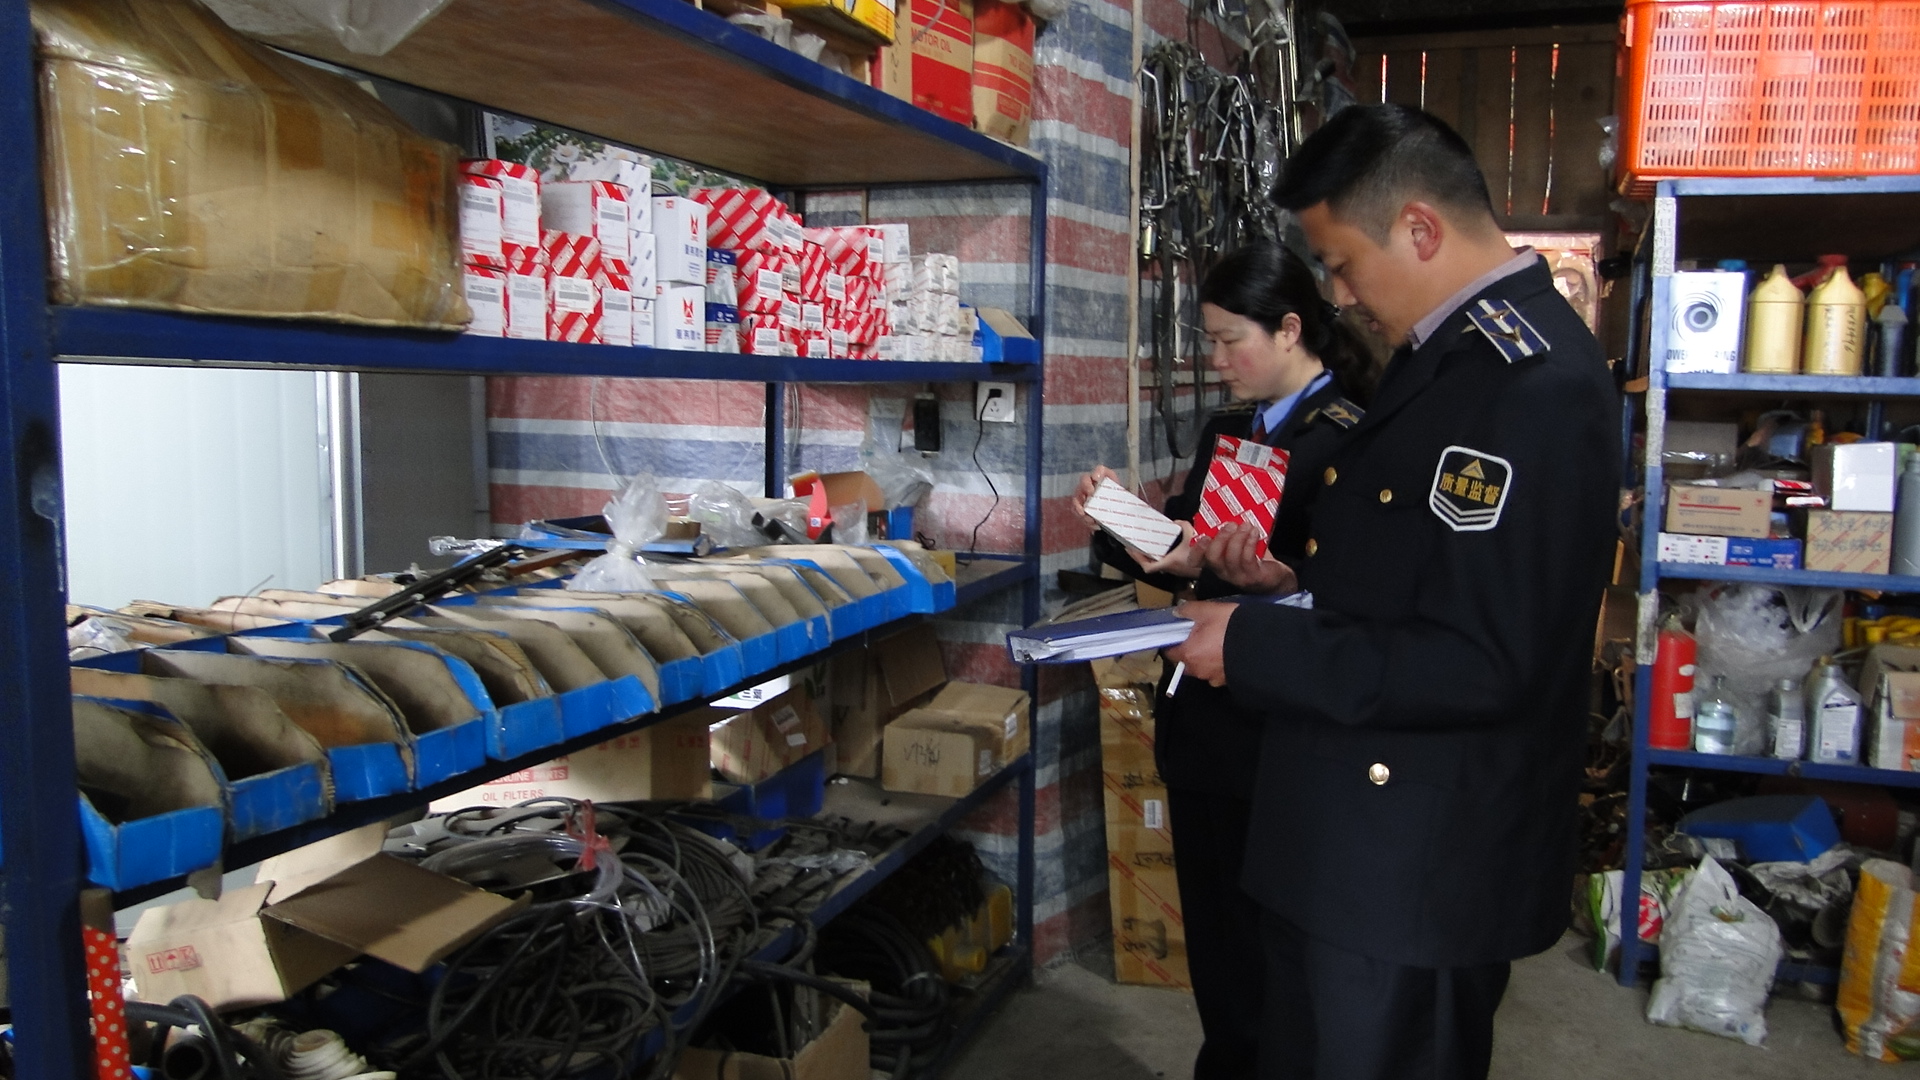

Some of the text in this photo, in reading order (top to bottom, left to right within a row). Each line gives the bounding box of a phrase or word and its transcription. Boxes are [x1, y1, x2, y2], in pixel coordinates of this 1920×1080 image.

[911, 27, 939, 48] MOTOR
[941, 38, 952, 53] OIL
[1666, 349, 1688, 361] OWE
[1439, 472, 1500, 505] 质量监督
[482, 788, 545, 802] OIL FILTERS
